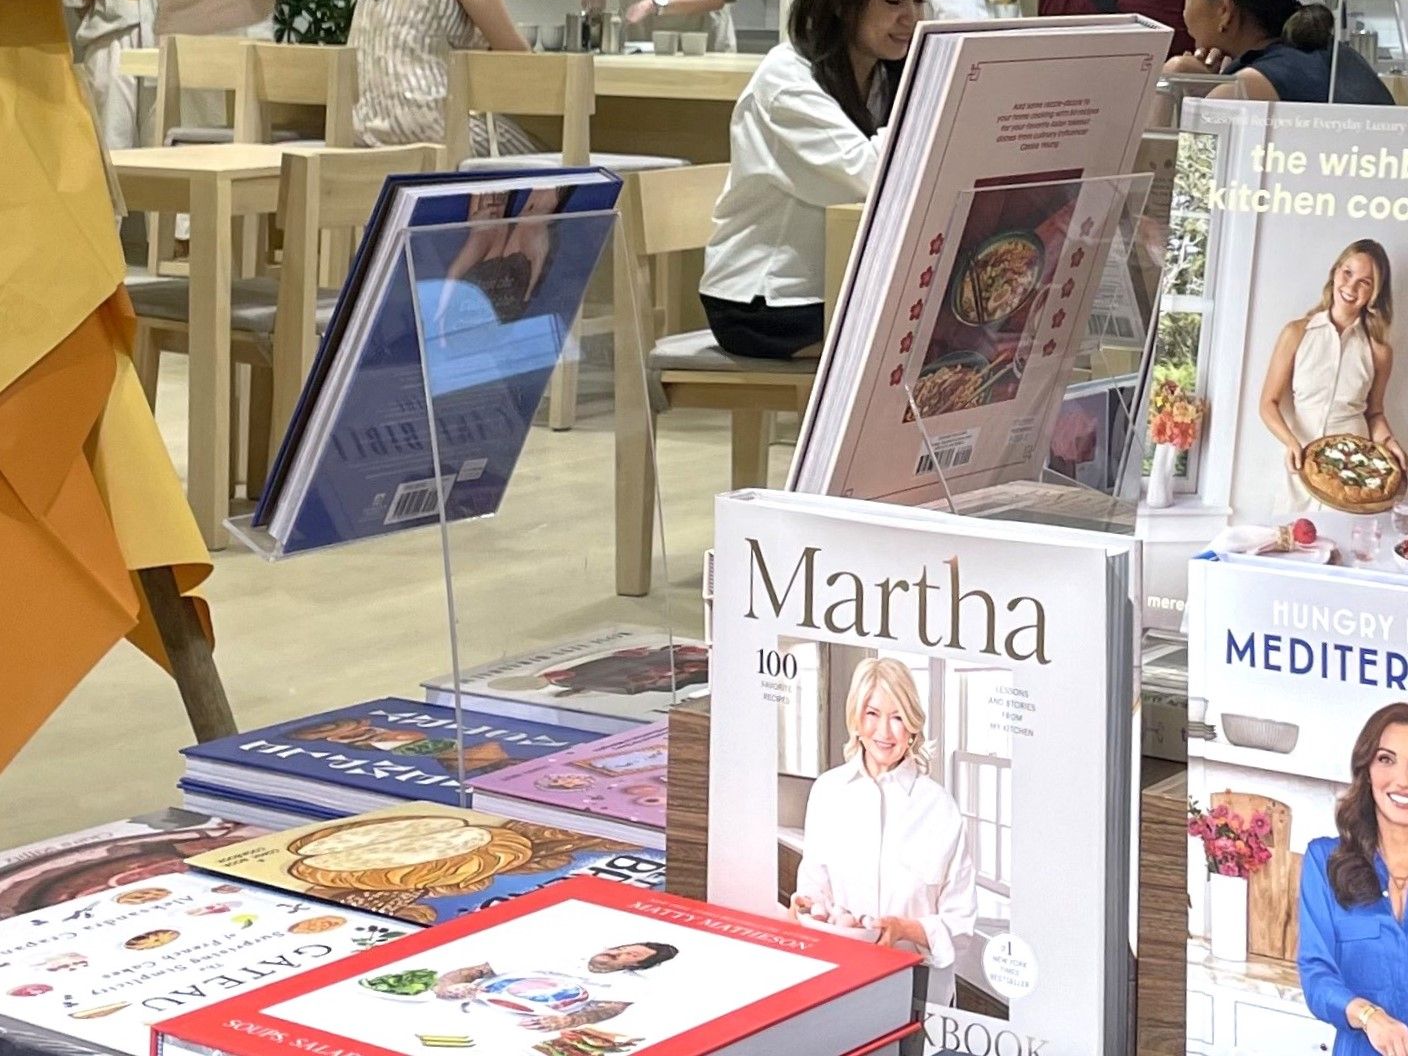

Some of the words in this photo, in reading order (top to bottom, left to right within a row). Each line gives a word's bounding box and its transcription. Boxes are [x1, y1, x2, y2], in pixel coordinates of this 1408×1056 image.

[1312, 117, 1363, 135] Everyday
[1365, 119, 1406, 136] Luxury
[1250, 142, 1308, 176] the
[1207, 178, 1336, 217] kitchen
[743, 537, 1053, 665] Martha
[1146, 594, 1185, 612] mere
[1273, 599, 1393, 645] HUNGRY
[756, 648, 798, 680] 100
[83, 895, 195, 932] Aleksandra
[627, 900, 697, 924] MATTY
[701, 917, 815, 951] MATHESON
[0, 931, 78, 956] Crapan
[161, 937, 223, 962] French
[189, 929, 286, 965] Surprising
[91, 962, 188, 995] Simplicity
[101, 960, 157, 979] Cakes
[222, 1018, 289, 1044] SOUPS,
